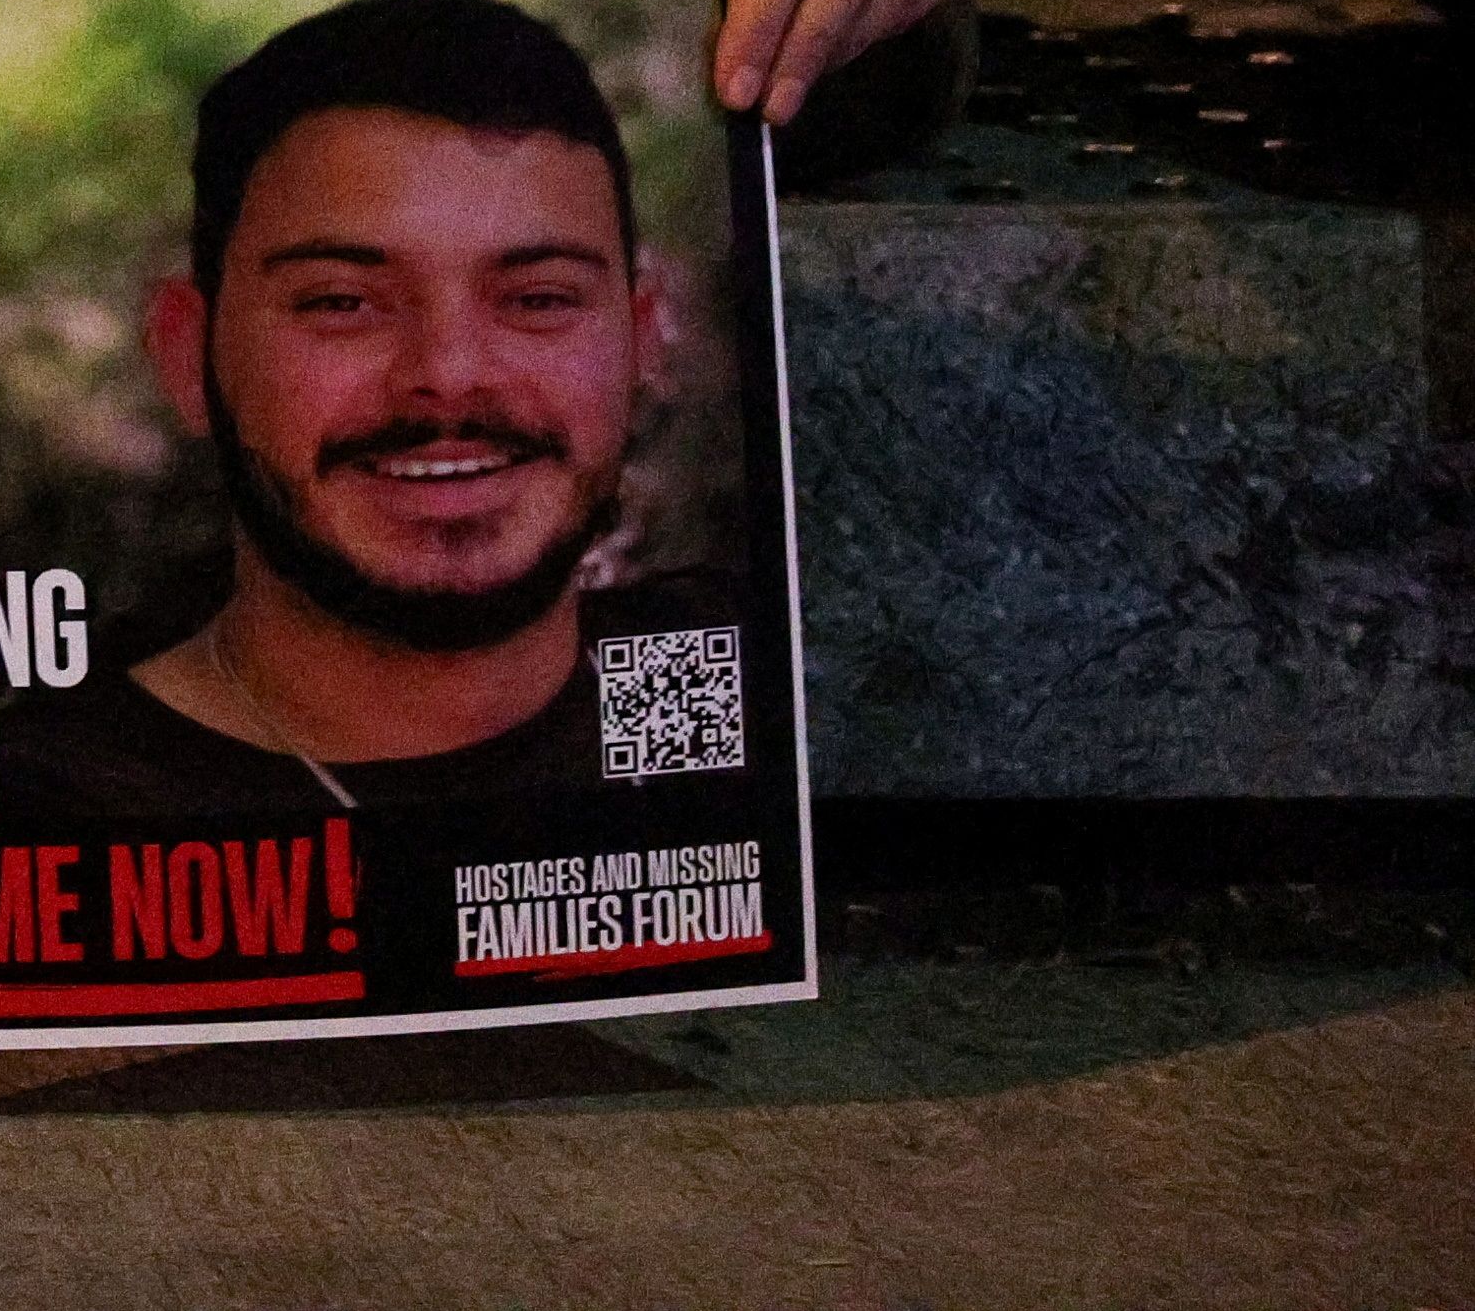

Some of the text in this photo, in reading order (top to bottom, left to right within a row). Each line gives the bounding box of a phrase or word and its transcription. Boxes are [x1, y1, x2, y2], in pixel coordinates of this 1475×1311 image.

[110, 818, 357, 960] NOW!
[455, 841, 760, 903] HOSTAGES AND MISSING
[456, 883, 762, 962] FAMILIES FORUM
